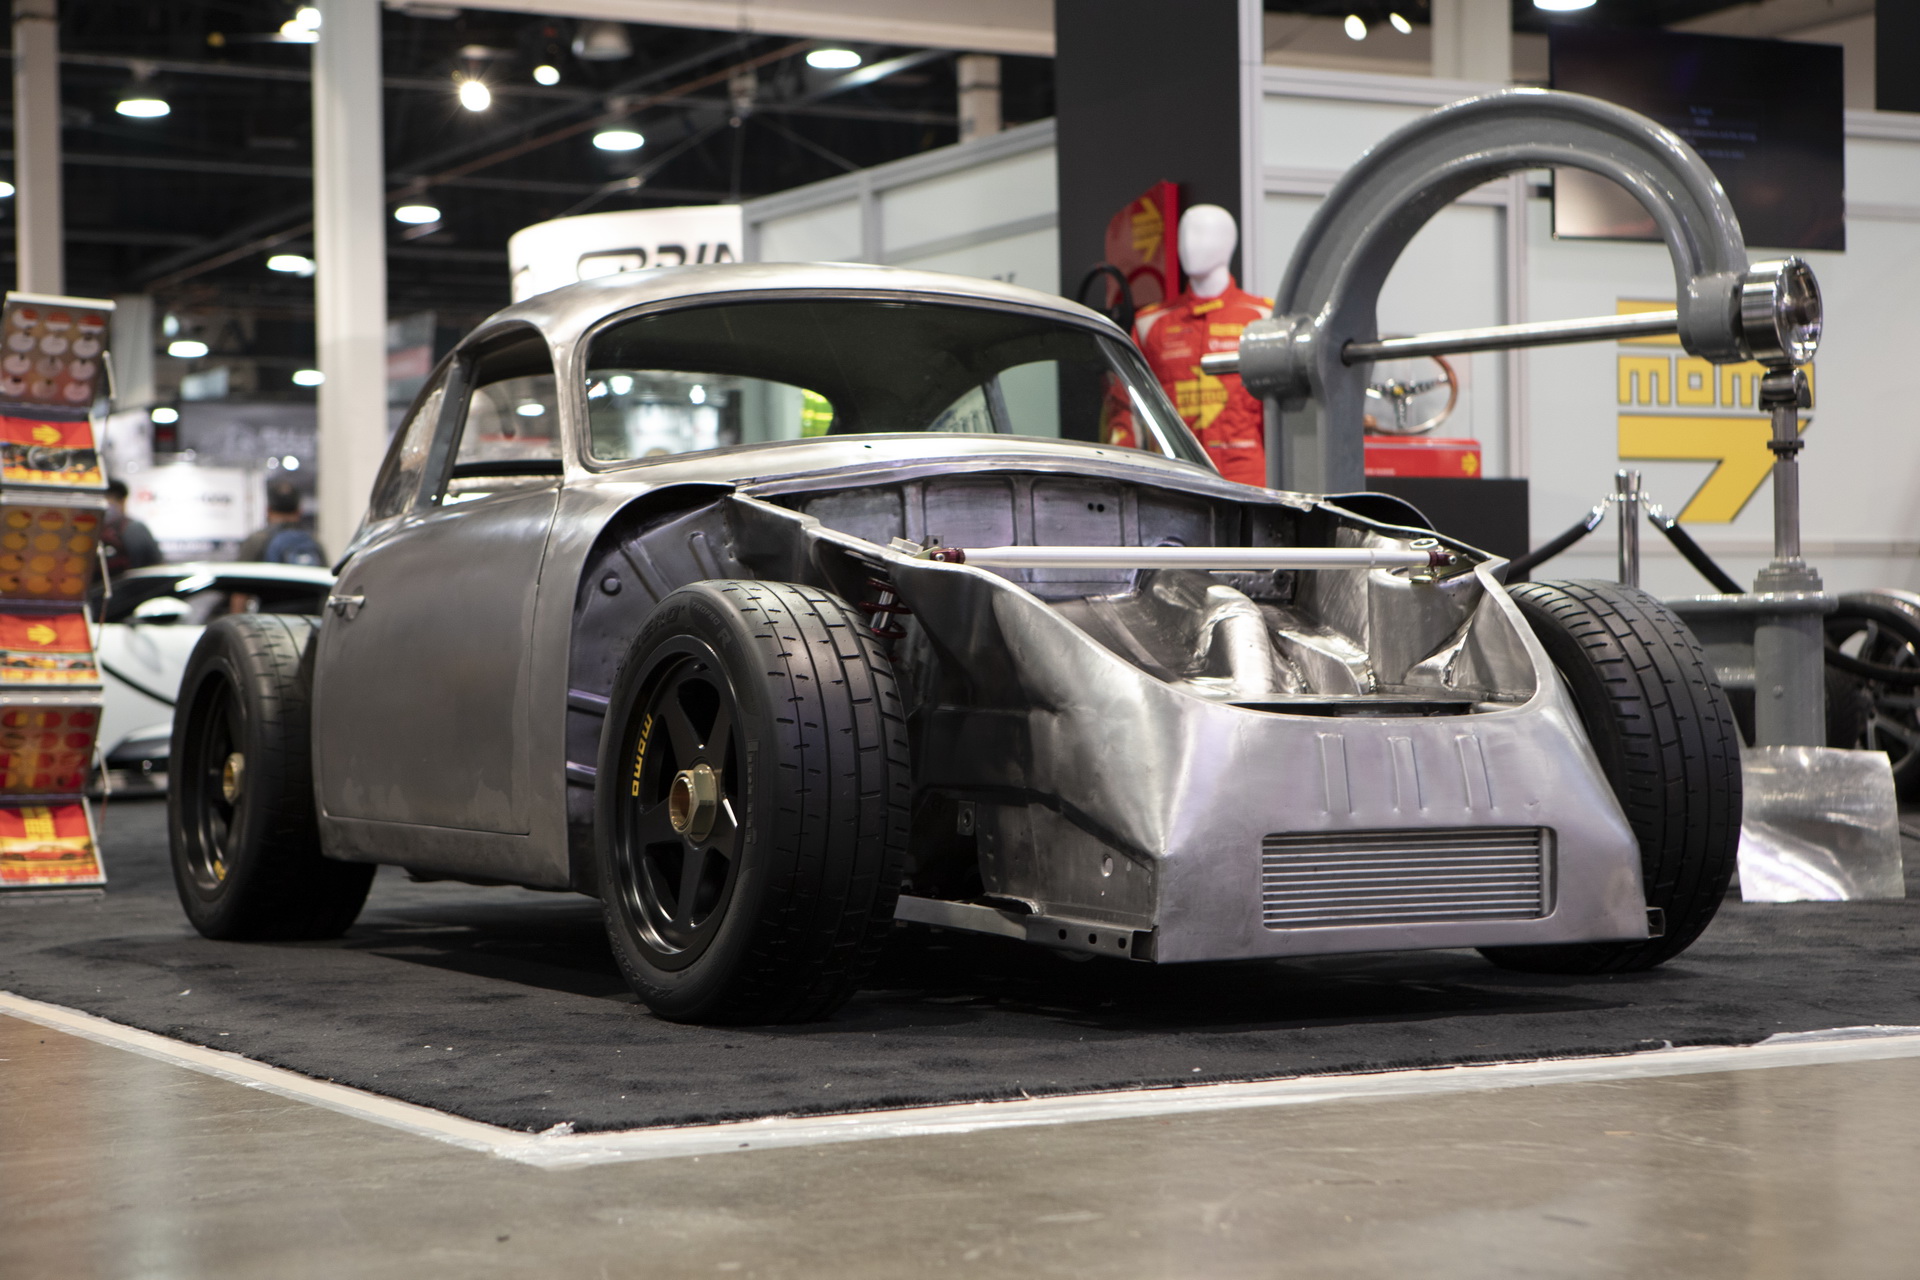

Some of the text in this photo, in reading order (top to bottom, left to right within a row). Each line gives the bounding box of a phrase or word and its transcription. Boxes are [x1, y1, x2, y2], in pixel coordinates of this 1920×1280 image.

[1617, 355, 1816, 408] mom
[692, 601, 721, 626] TROFEO
[632, 713, 653, 797] momo
